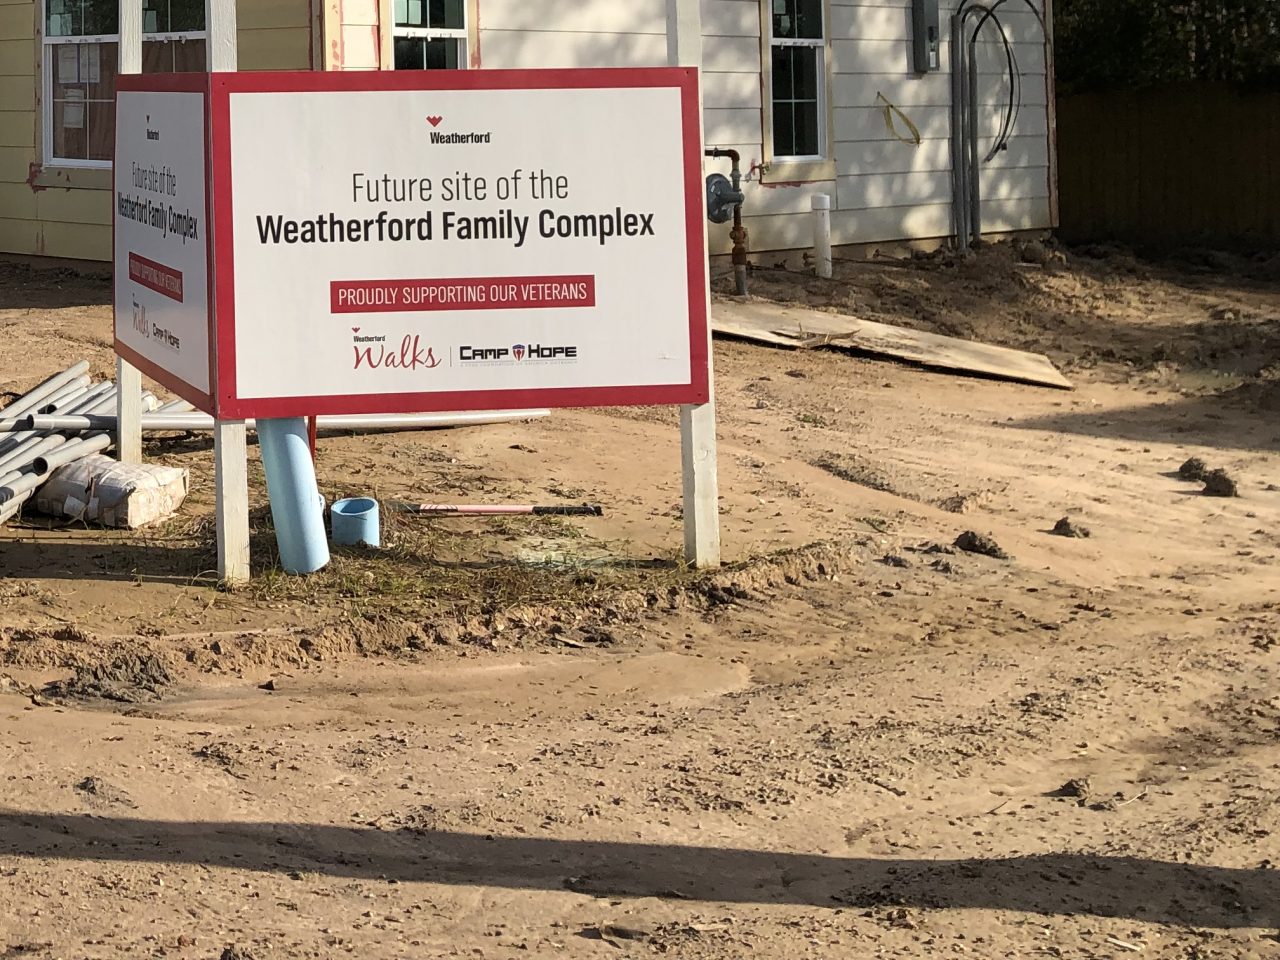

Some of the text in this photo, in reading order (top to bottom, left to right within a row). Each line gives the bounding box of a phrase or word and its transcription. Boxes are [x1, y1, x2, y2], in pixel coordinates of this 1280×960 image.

[430, 131, 490, 144] Weatherford
[352, 169, 569, 203] Future site of the
[256, 206, 655, 247] Weatherford Family Complex
[338, 283, 588, 306] PROUDLY SUPPORTING OUR VETERANS
[353, 334, 442, 371] Walks
[459, 344, 577, 360] CAMP HOPE
